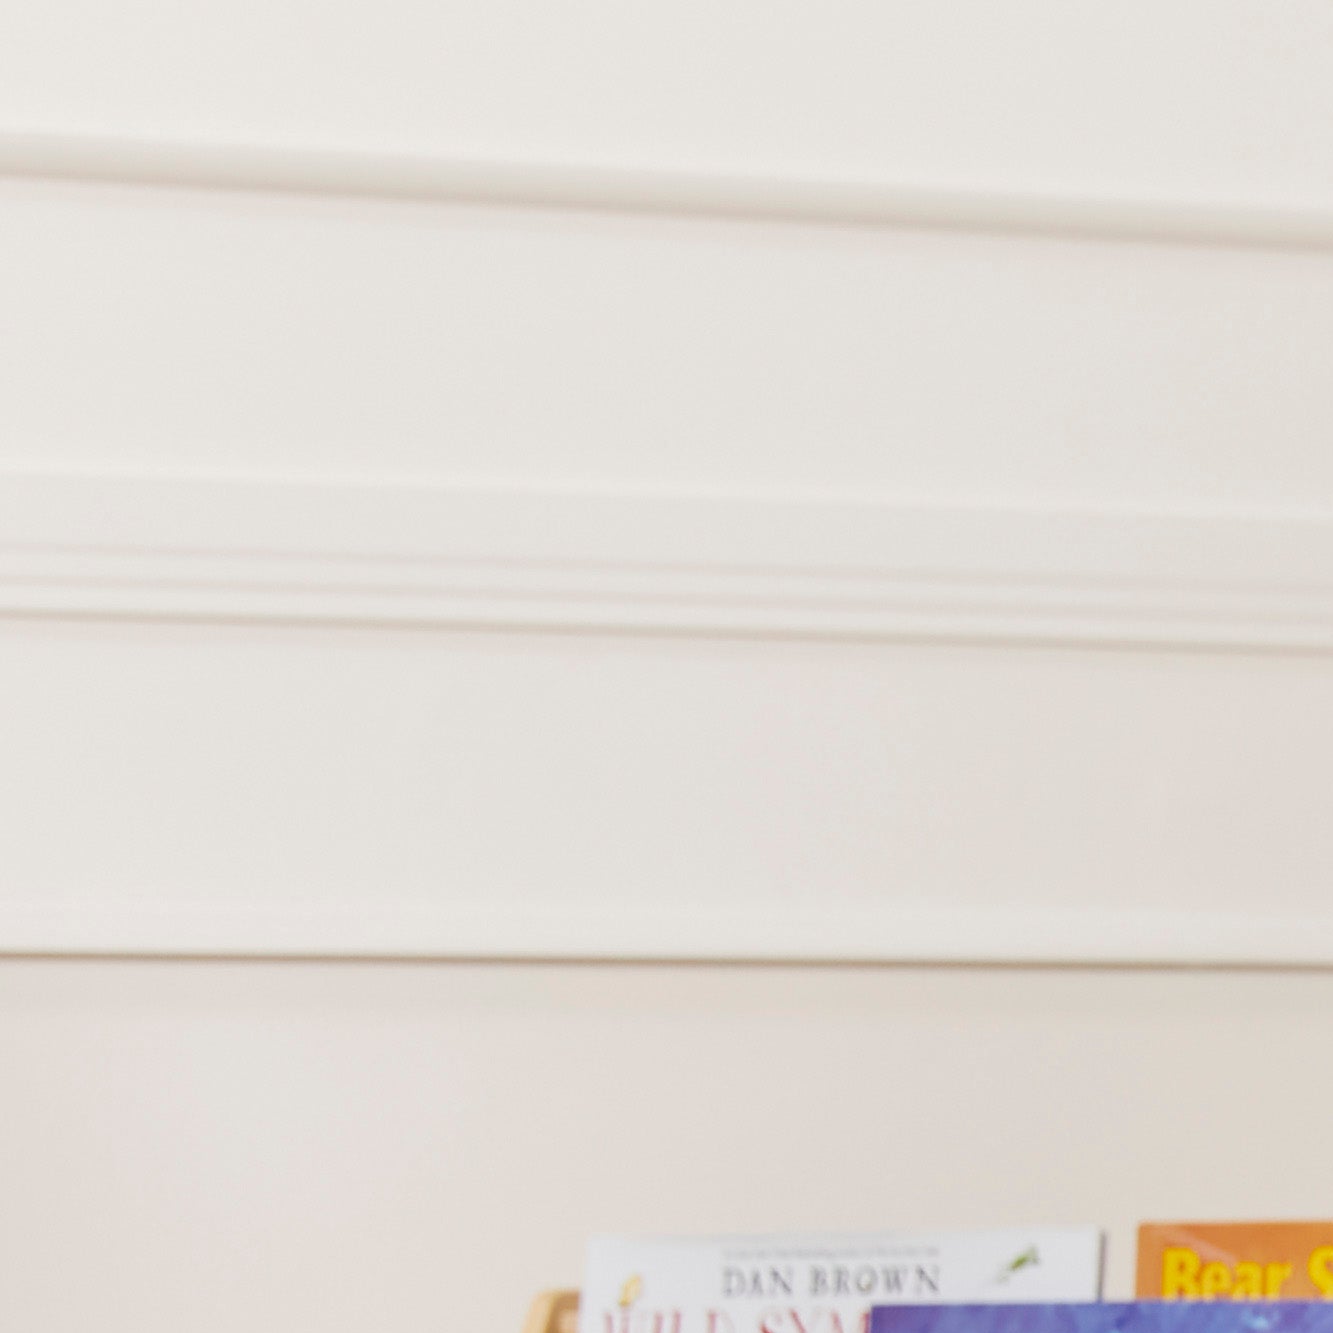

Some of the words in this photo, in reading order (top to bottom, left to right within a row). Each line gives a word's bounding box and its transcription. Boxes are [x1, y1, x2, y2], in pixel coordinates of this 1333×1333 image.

[722, 1263, 793, 1296] DAN
[809, 1263, 940, 1296] BROWN
[1162, 1246, 1293, 1302] Bear
